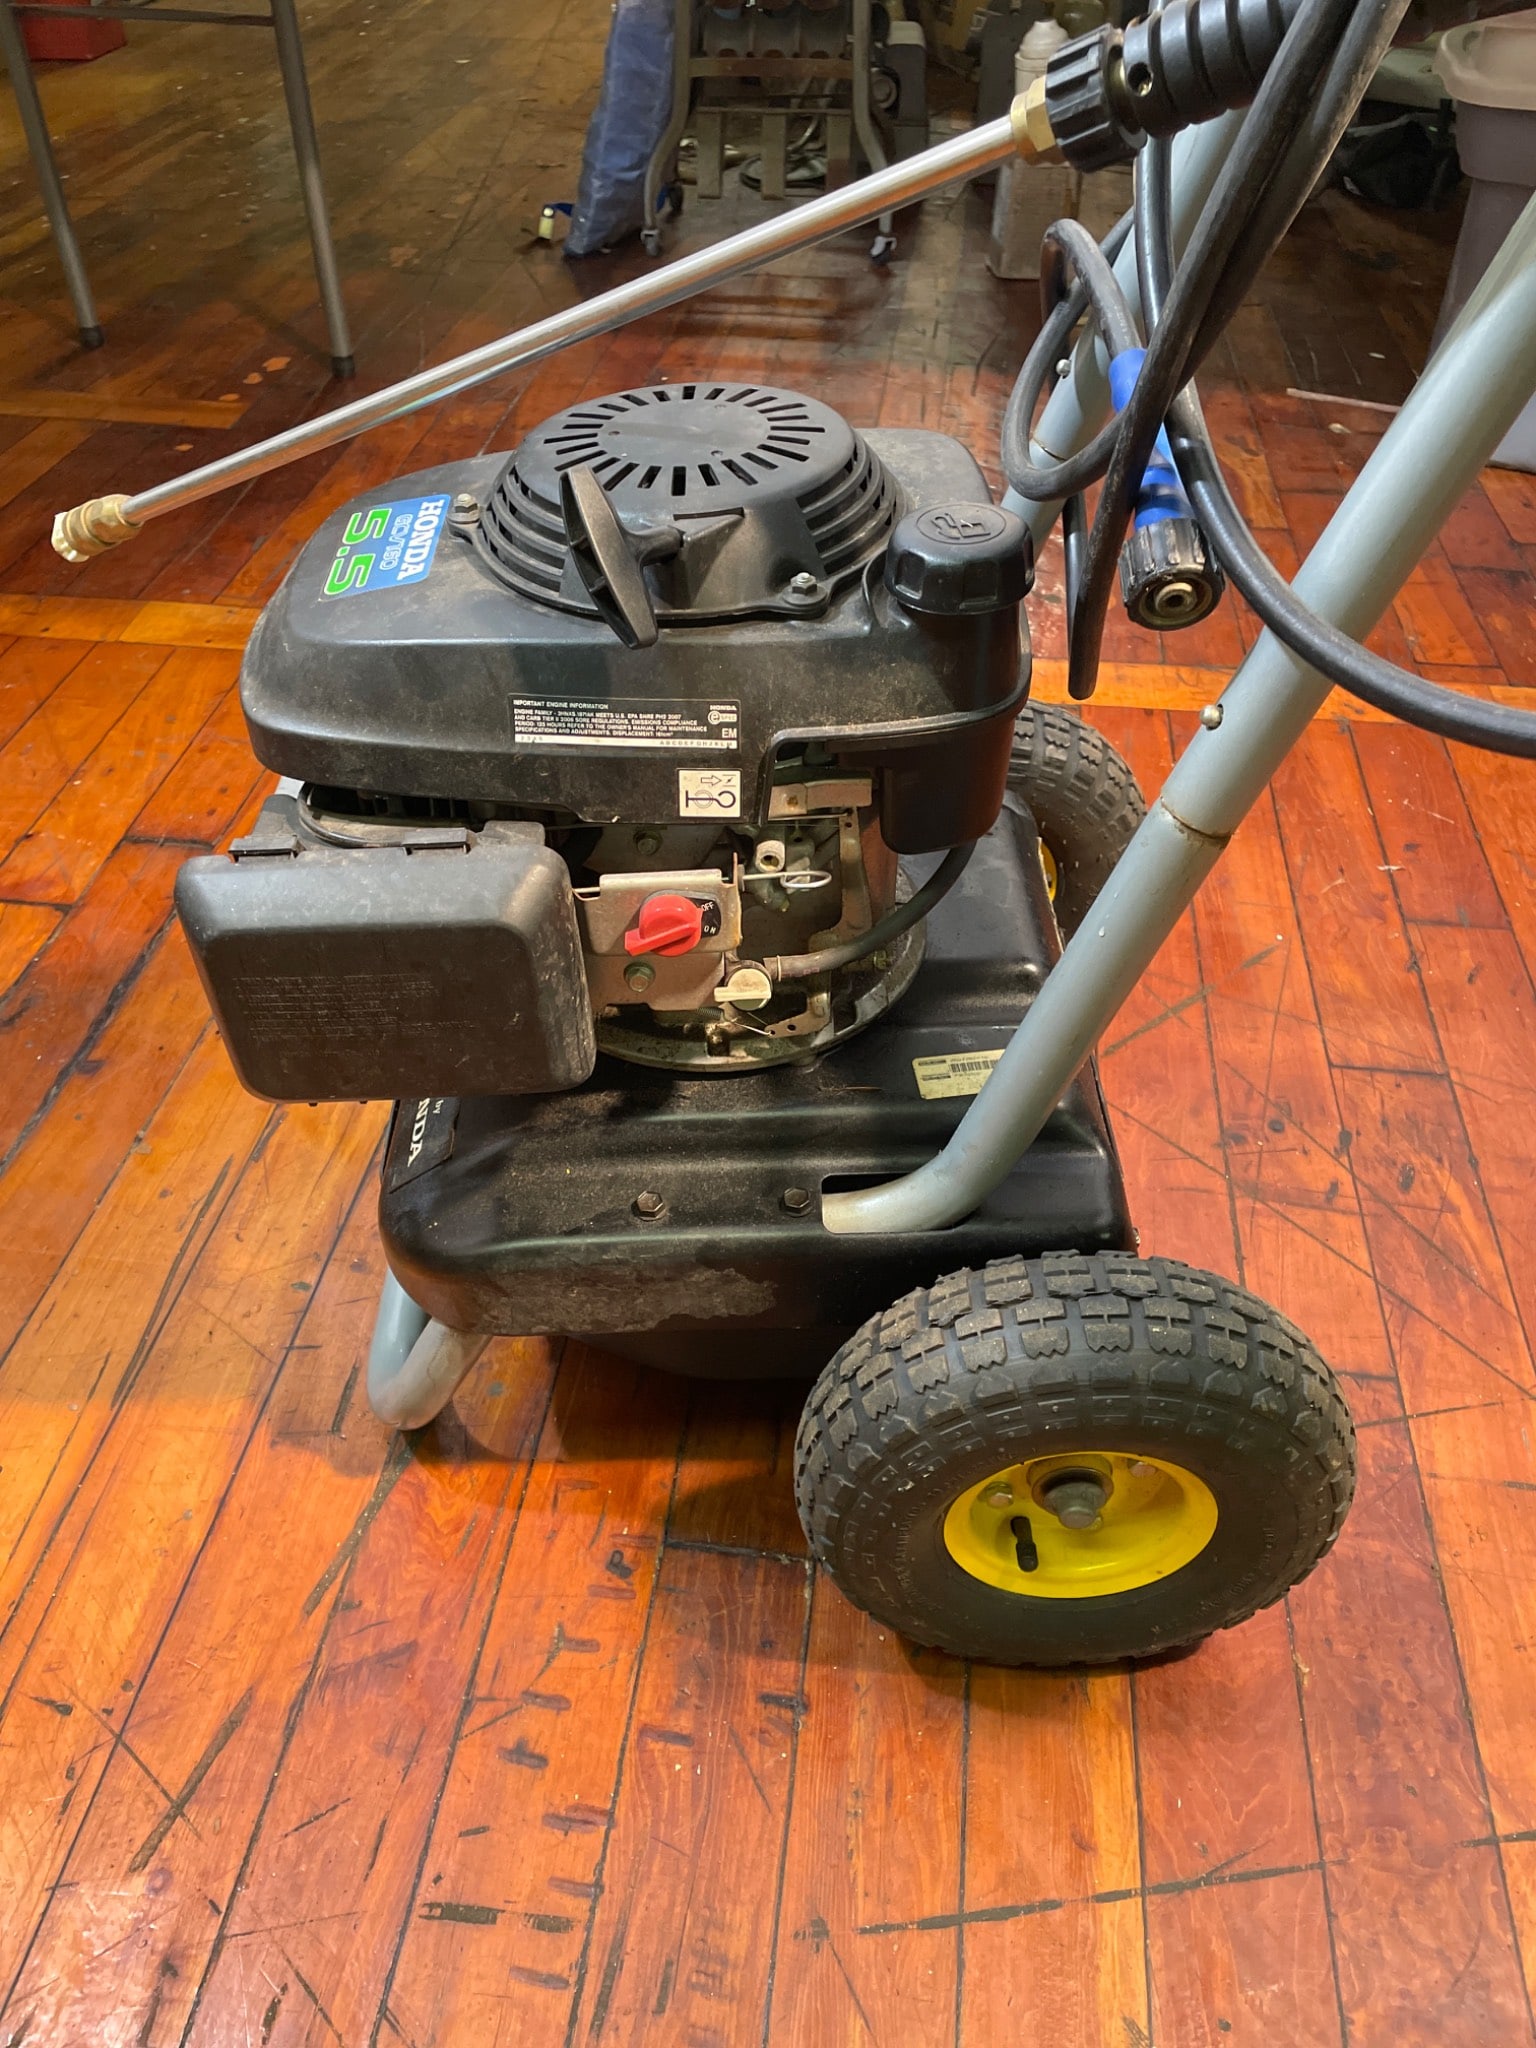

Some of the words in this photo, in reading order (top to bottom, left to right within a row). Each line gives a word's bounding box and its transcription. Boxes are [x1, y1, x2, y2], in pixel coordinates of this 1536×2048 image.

[323, 508, 392, 595] 5.5
[397, 499, 445, 581] HONDA
[722, 728, 737, 738] EM
[701, 901, 714, 911] OFF
[704, 925, 717, 934] ON
[407, 1097, 431, 1167] NDA
